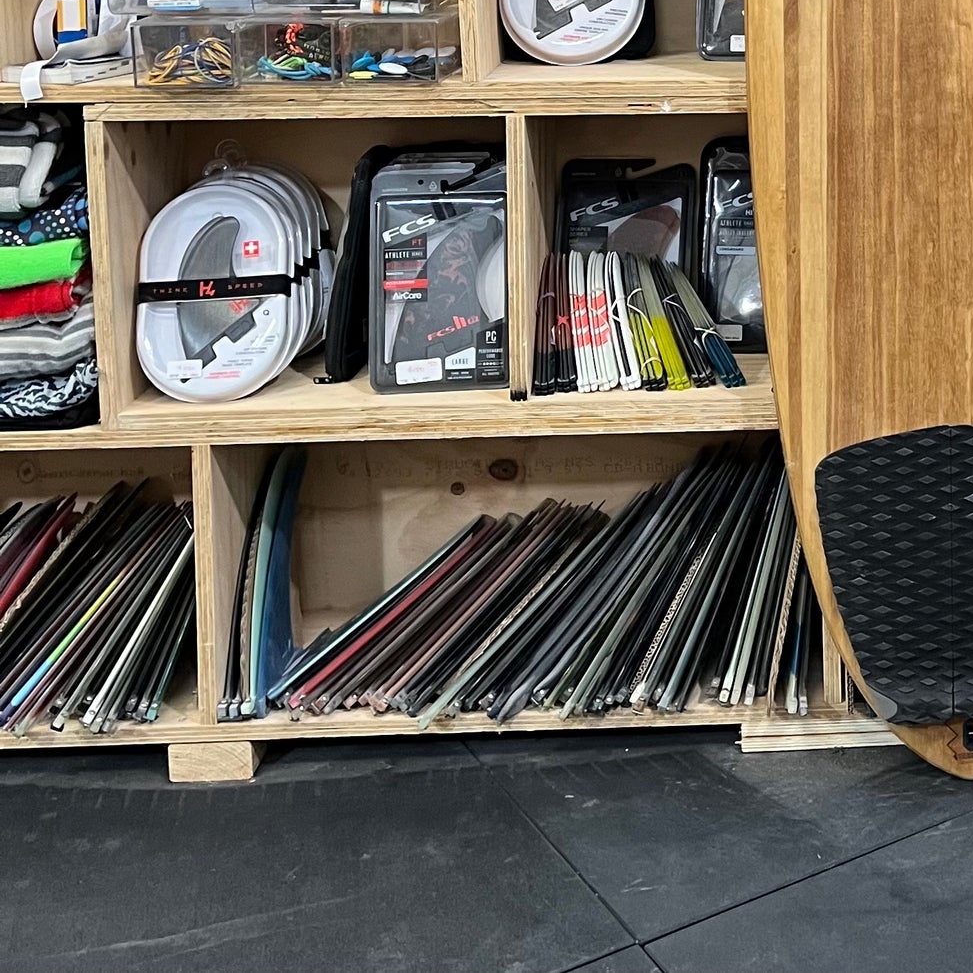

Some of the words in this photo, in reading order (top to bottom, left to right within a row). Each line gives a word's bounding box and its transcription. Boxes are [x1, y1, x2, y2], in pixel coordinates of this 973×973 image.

[570, 196, 620, 222] FCS
[382, 213, 436, 244] FCS
[384, 250, 410, 259] ATHLETE
[227, 282, 264, 290] SPEED
[392, 291, 422, 301] AirCore
[485, 330, 497, 342] PC
